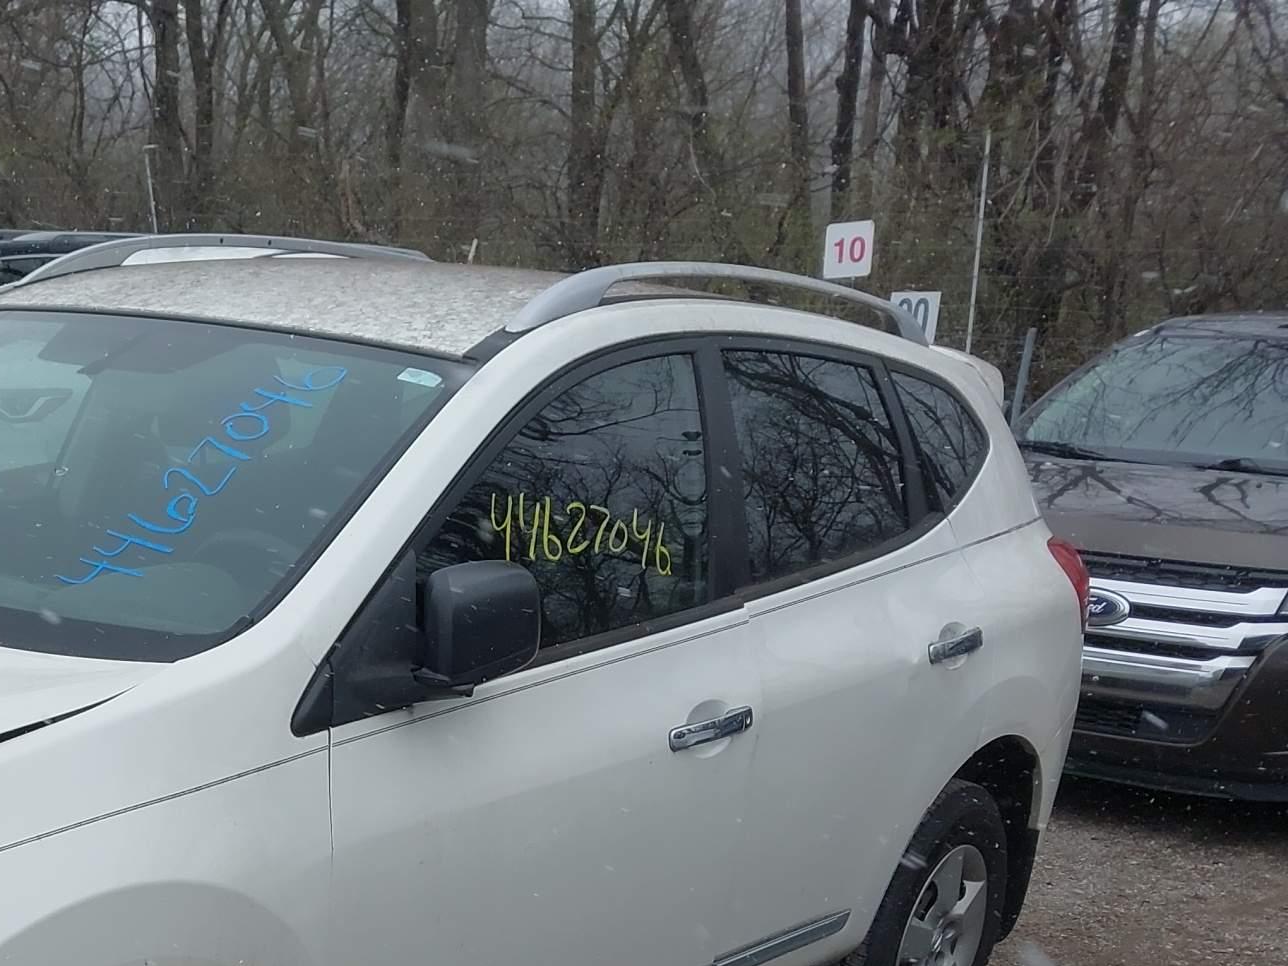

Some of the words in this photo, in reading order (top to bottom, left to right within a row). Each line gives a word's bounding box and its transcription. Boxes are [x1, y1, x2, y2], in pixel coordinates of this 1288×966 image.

[834, 237, 866, 264] 10
[54, 366, 348, 585] 44627046
[491, 491, 672, 576] 44627046
